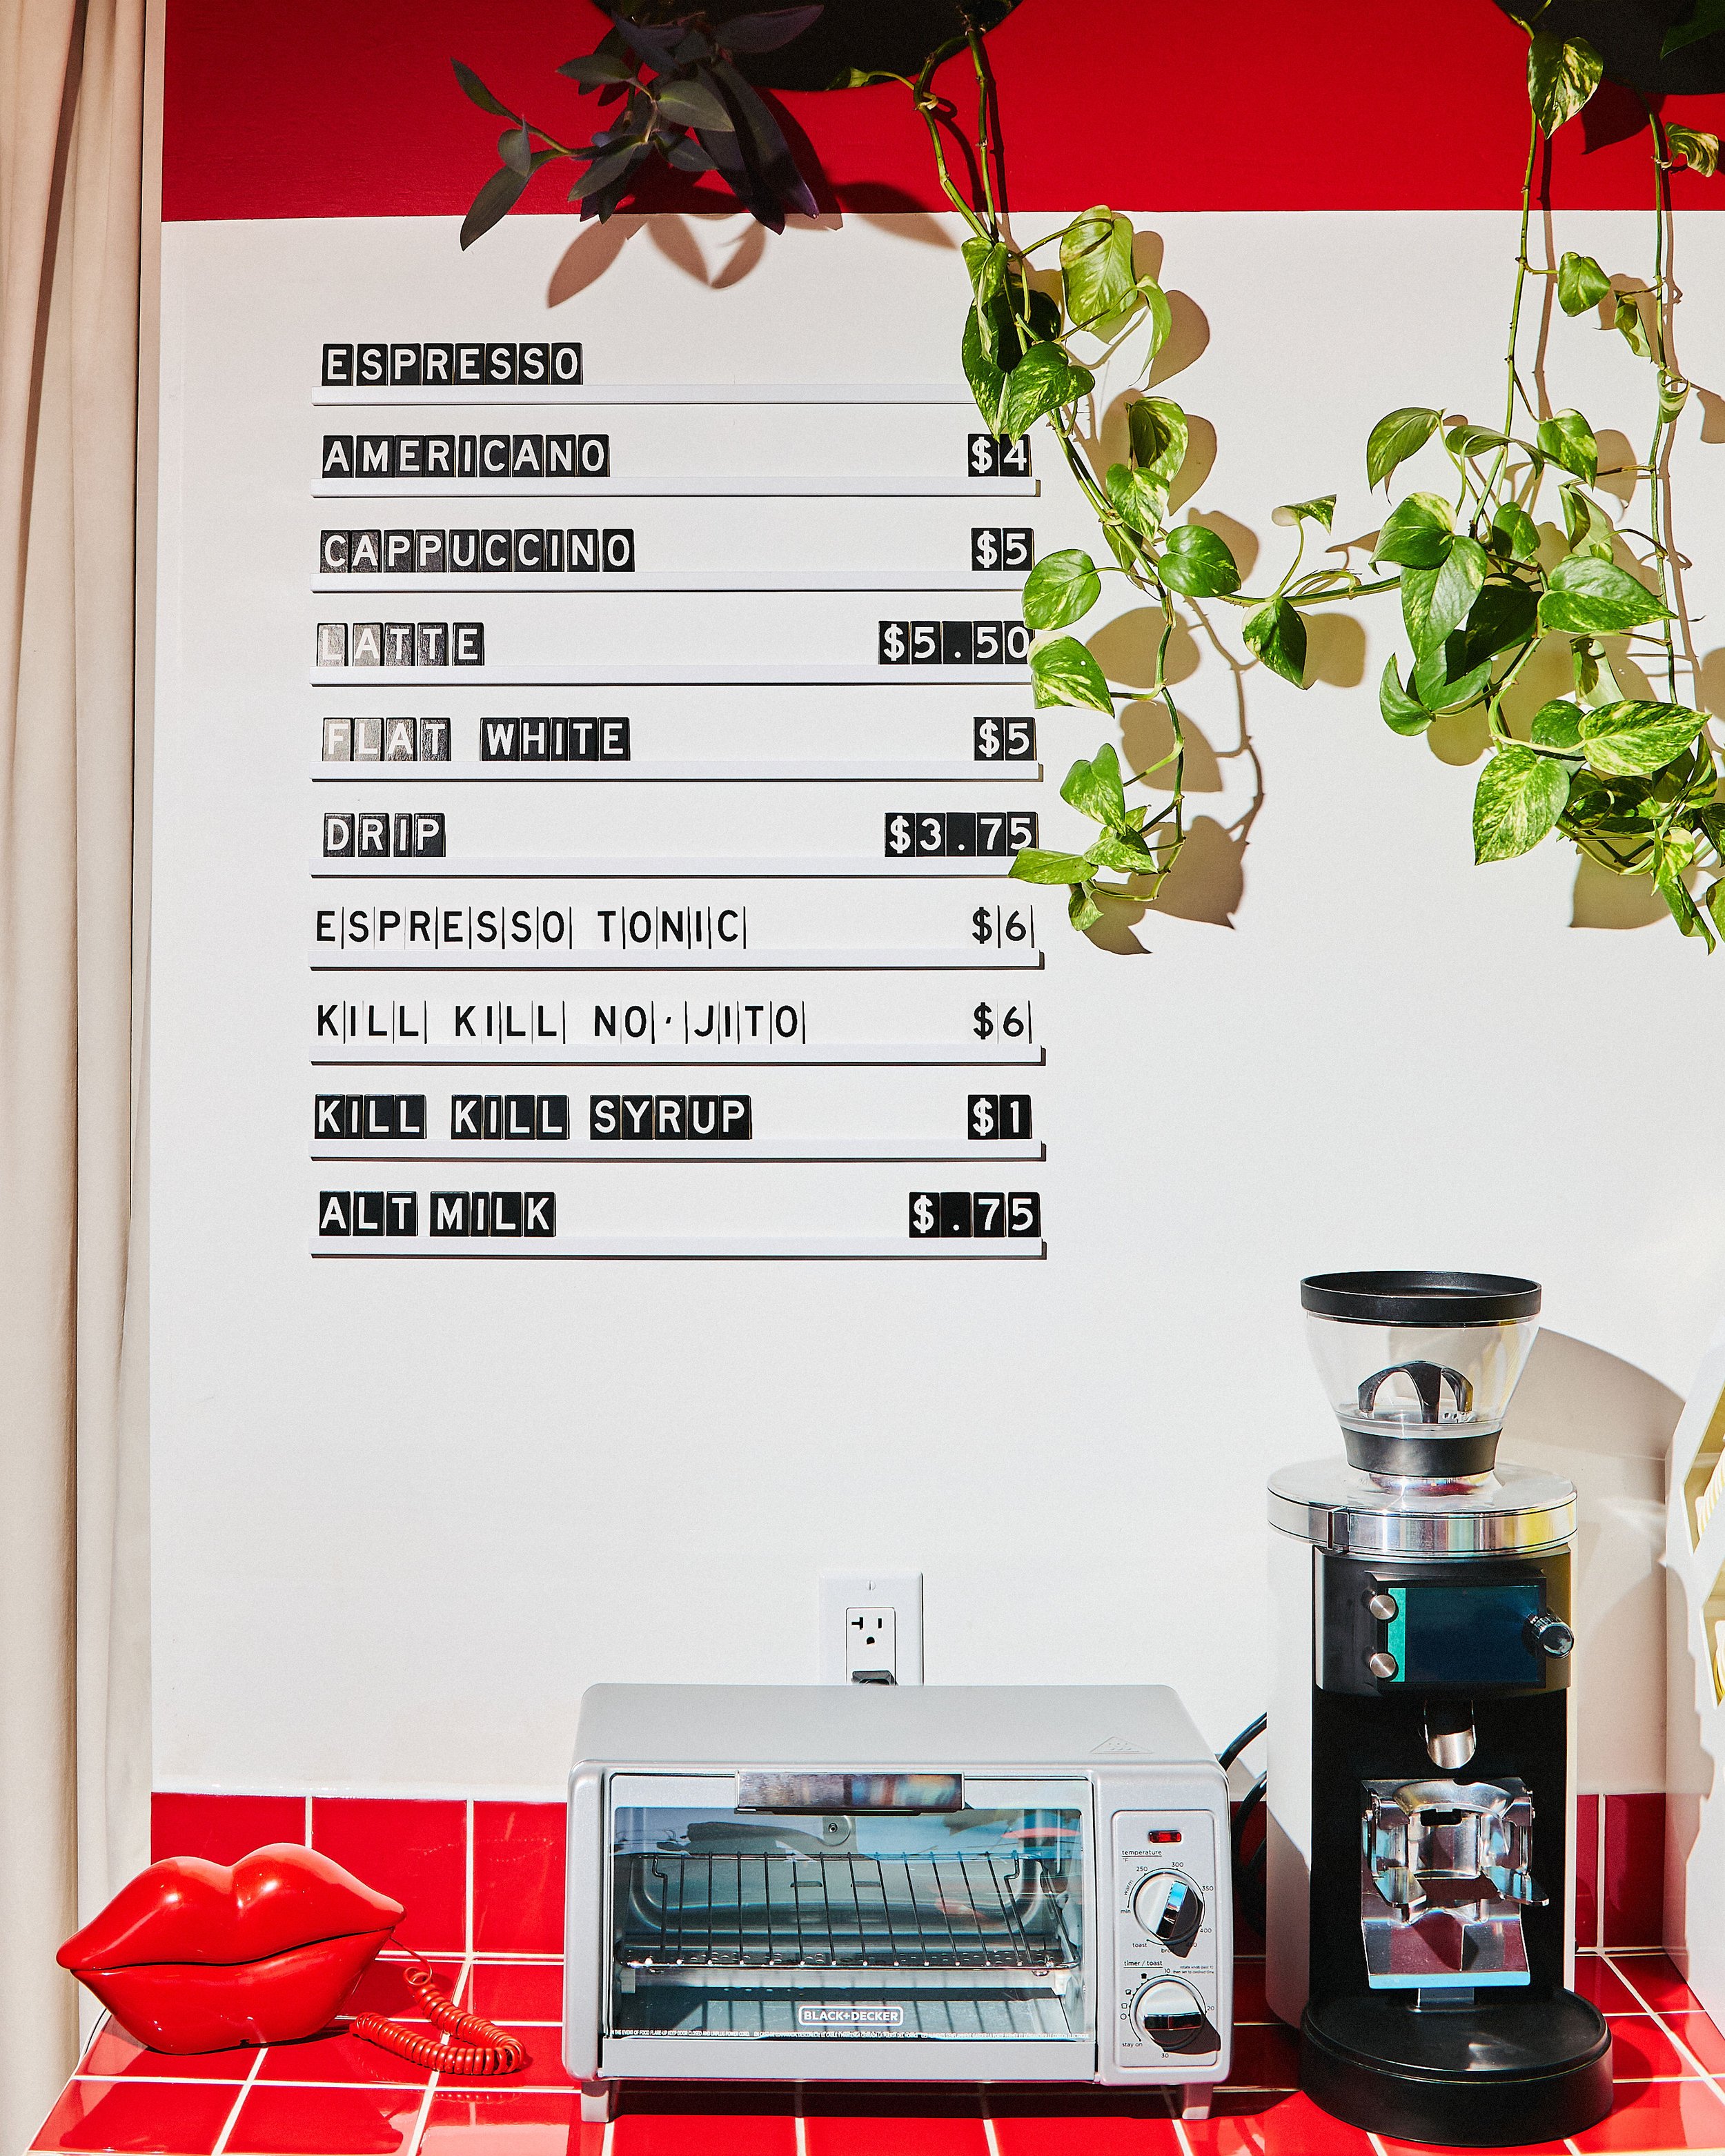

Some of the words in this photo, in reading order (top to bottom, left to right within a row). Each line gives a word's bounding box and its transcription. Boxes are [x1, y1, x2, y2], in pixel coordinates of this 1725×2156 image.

[326, 347, 580, 380] ESPRESSO
[324, 439, 605, 472] AMERICANO
[971, 436, 1027, 474] $4
[324, 533, 630, 566] CAPPUCCINO
[976, 530, 1027, 568] $5
[321, 629, 479, 660] LATTE
[883, 623, 1029, 662] $5.50
[327, 723, 446, 755] FLAT
[486, 722, 624, 755] WHITE
[978, 719, 1029, 758] $5
[327, 818, 440, 851] DRIP
[889, 815, 1032, 854] $3.75
[315, 909, 566, 943] ESPRESSO
[598, 909, 740, 942] TONIC
[972, 907, 1027, 945] $6
[316, 1005, 421, 1037] KILL
[455, 1005, 558, 1038] KILL
[973, 1001, 1024, 1040] $6
[317, 1100, 422, 1134] KILL
[455, 1100, 564, 1134] KILL
[593, 1100, 746, 1134] SYRUP
[972, 1097, 1021, 1136] $1
[320, 1196, 413, 1230] ALT
[436, 1197, 550, 1231] MILK
[912, 1194, 1034, 1234] $.75
[1124, 1879, 1134, 1896] warm
[804, 2011, 898, 2021] BLACK+DECKER
